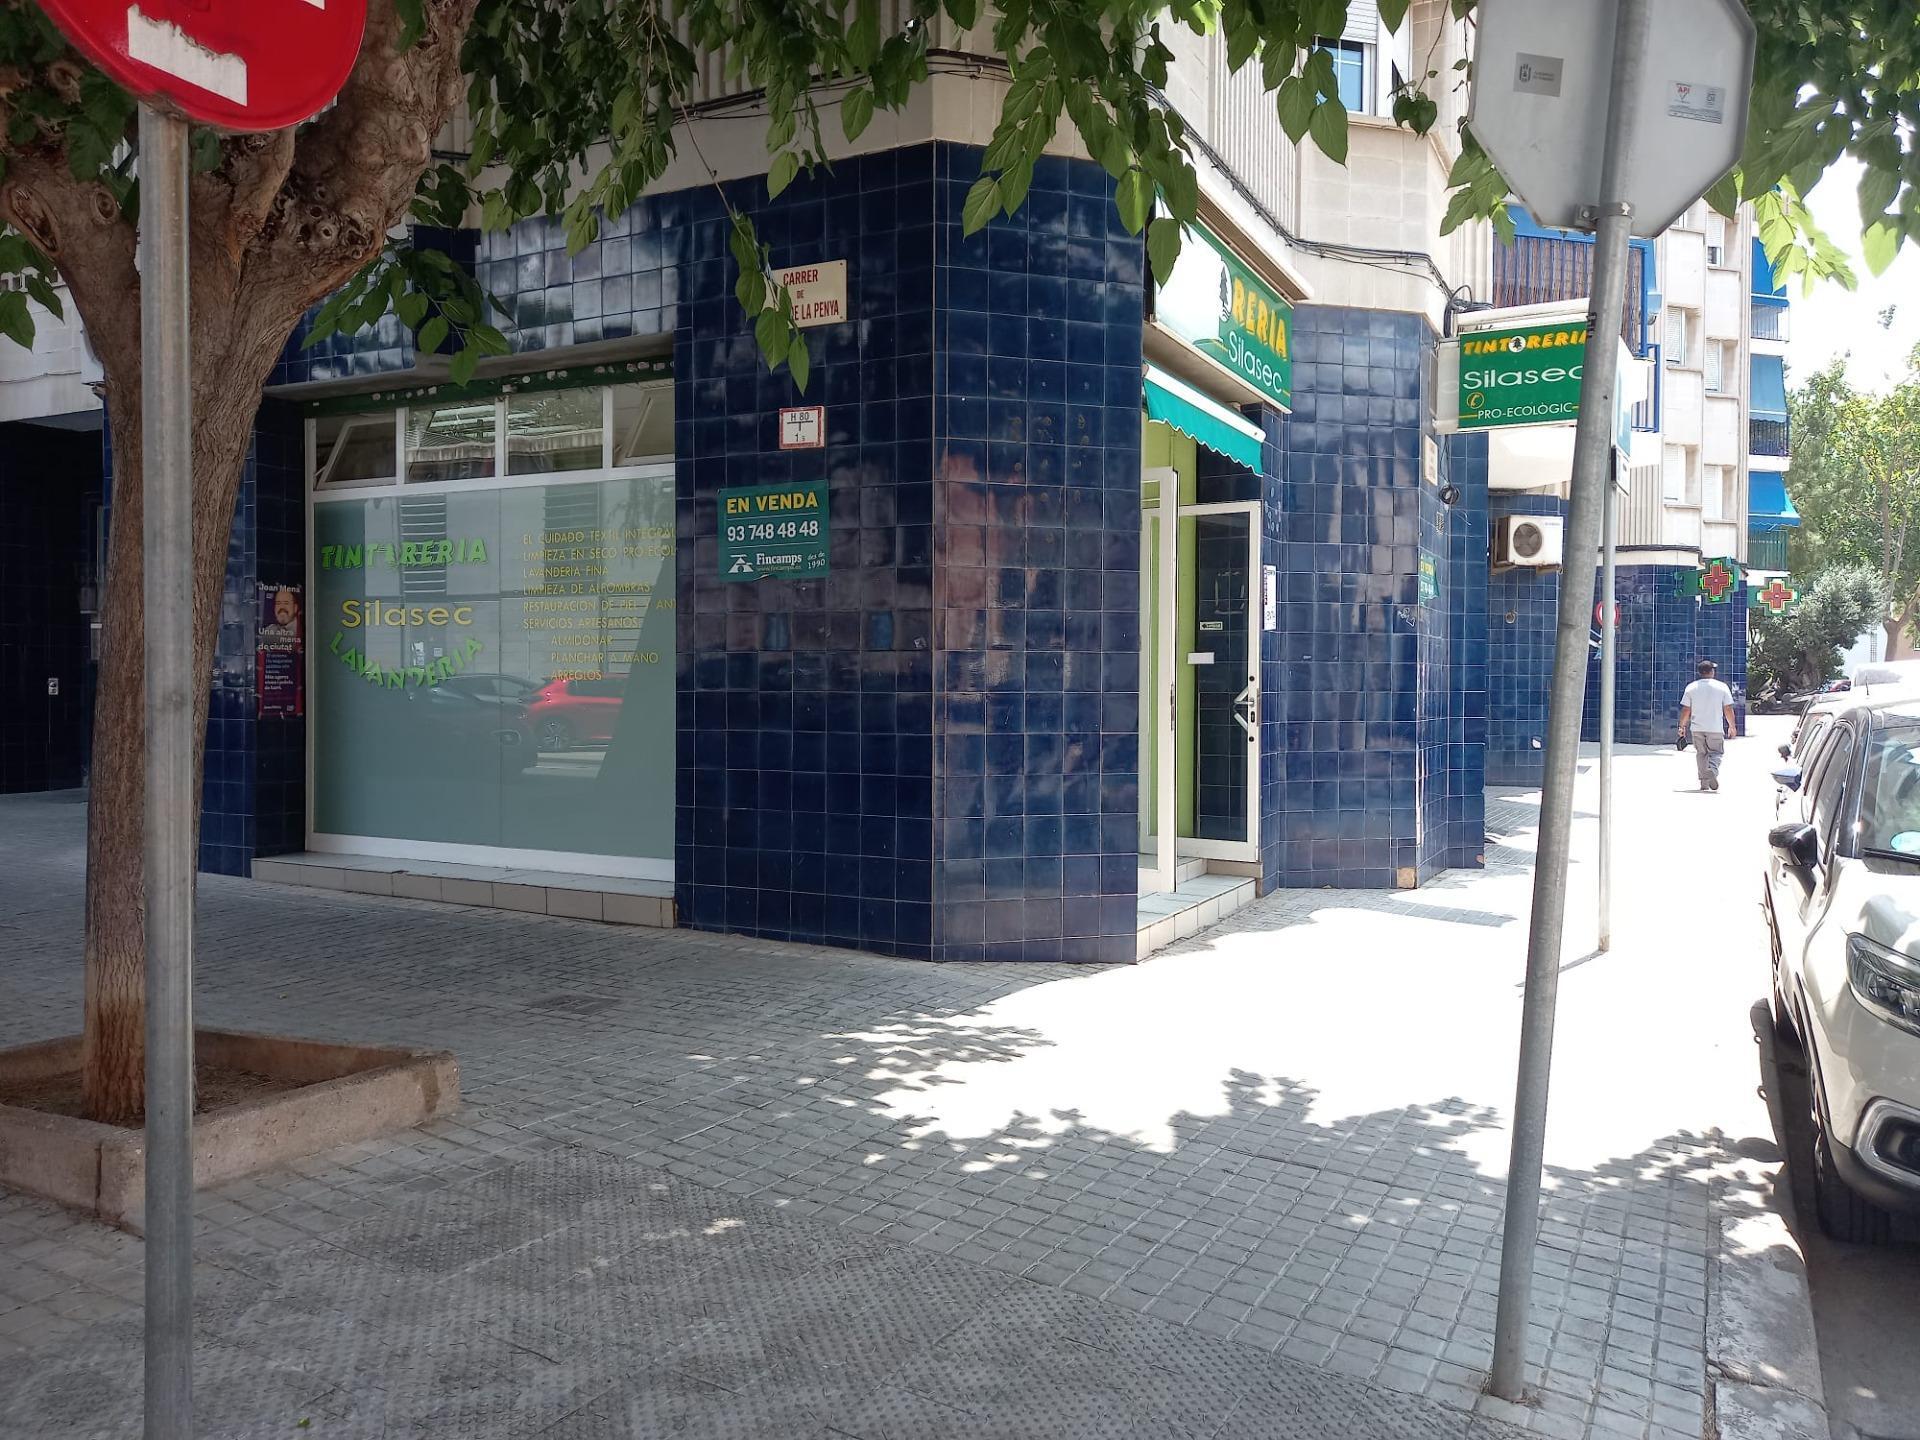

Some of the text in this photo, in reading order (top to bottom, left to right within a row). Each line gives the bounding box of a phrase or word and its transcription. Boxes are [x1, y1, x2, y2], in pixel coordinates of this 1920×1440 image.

[783, 269, 819, 286] CARRER
[796, 289, 805, 299] DE
[802, 303, 812, 320] LA
[814, 300, 839, 318] PENYA
[1228, 331, 1283, 394] Silasec
[790, 412, 810, 421] H 80
[727, 491, 818, 514] EN VENDA
[727, 520, 819, 542] 93 748 48 48
[523, 535, 533, 545] EL
[540, 532, 584, 544] CUIDADO
[590, 530, 619, 542] TEXTIL
[523, 550, 566, 562] LIMPIEZA
[571, 549, 585, 560] EN
[590, 548, 617, 560] SECO
[756, 553, 802, 566] Fincamps
[808, 559, 826, 569] 1990
[586, 565, 609, 576] FINA
[258, 583, 278, 592] Joan
[523, 581, 650, 596] LIMPIEZA DE ALFOMBRAS
[341, 600, 473, 628] Silasec
[523, 617, 639, 629] SERVICIOS ARTESANOS
[258, 627, 275, 636] Una
[258, 642, 293, 651] de ciutat
[551, 635, 614, 647] ALMIDONAR
[551, 652, 604, 664] PLANCHAR
[623, 652, 659, 664] MANO
[551, 669, 602, 681] ARREGLOS
